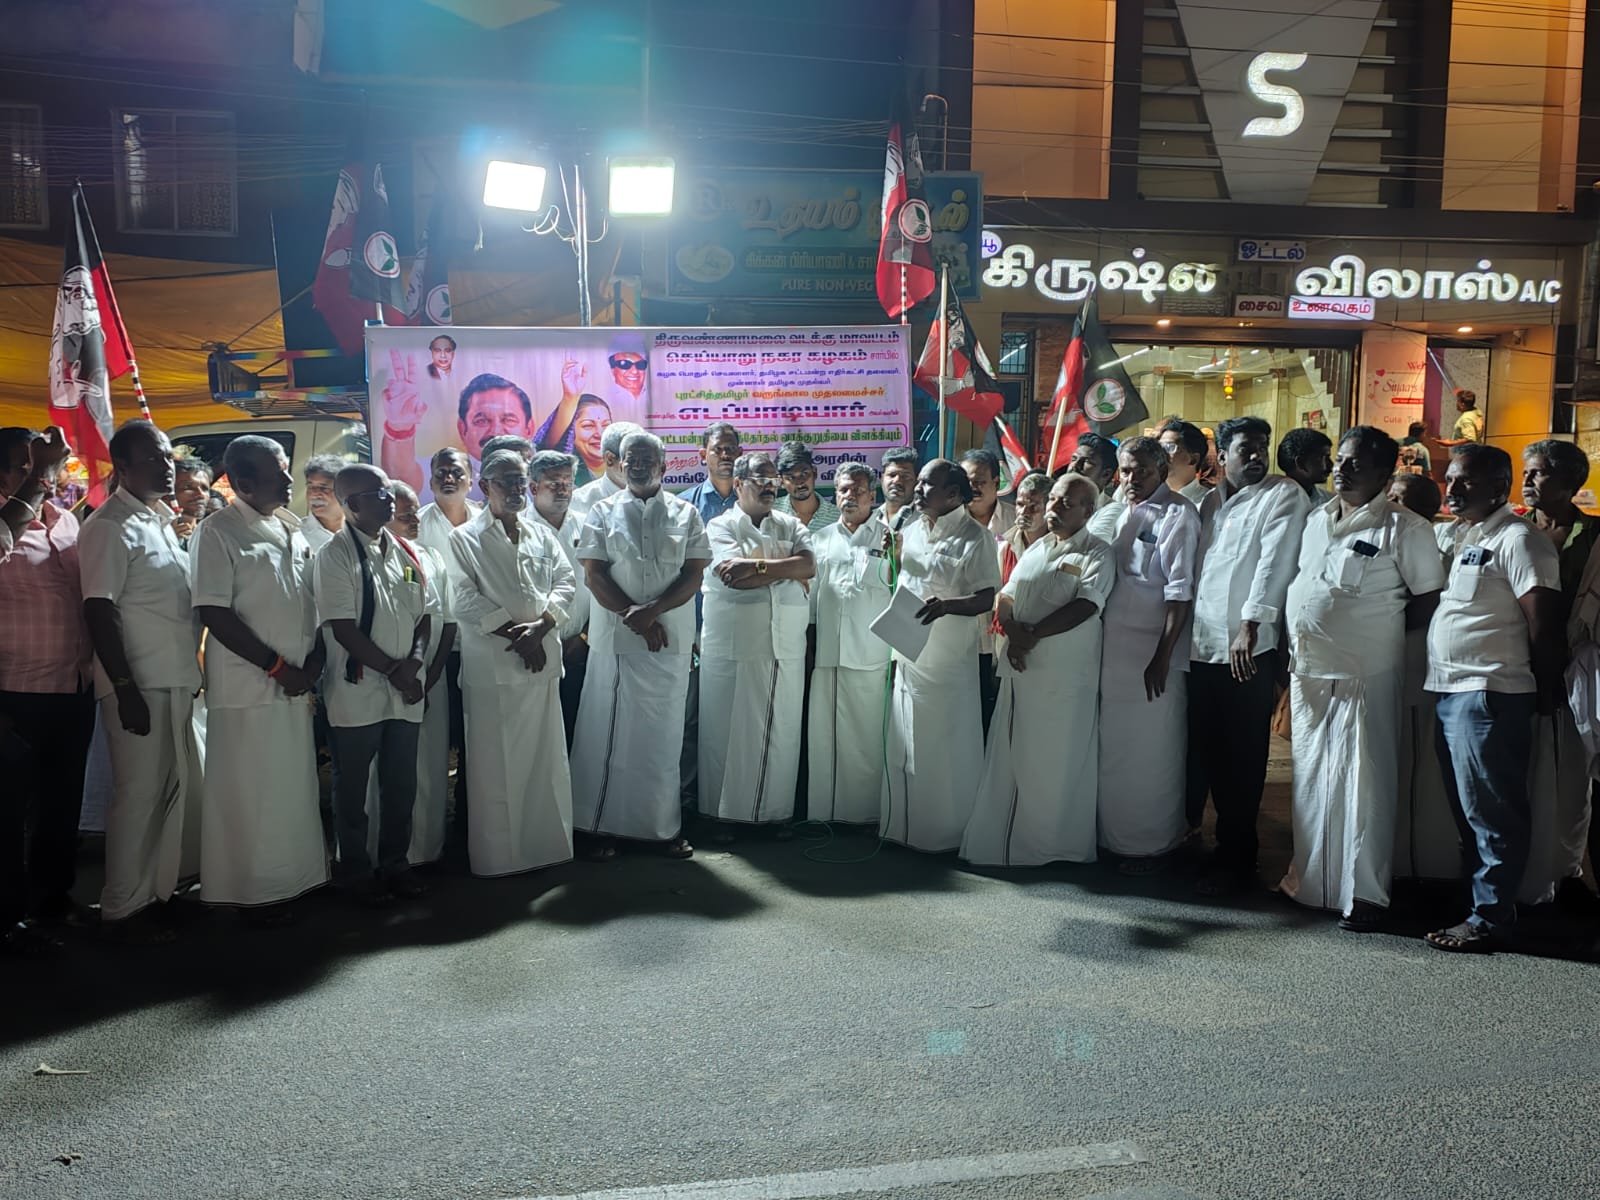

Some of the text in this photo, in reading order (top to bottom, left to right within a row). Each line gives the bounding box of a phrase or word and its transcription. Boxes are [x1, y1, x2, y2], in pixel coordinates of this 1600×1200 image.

[1242, 52, 1308, 136] S
[782, 279, 812, 291] PURE
[1295, 255, 1519, 302] விலாஸ்
[1519, 280, 1561, 303] A/C
[1238, 299, 1372, 315] சைவ உணவகம்
[655, 330, 900, 348] திருவண்ணாமலை வடக்கு மாவட்டம்
[666, 349, 900, 366] செய்யாறு நகர கழகம் சார்பில்
[678, 401, 867, 422] எடப்பாடியார்
